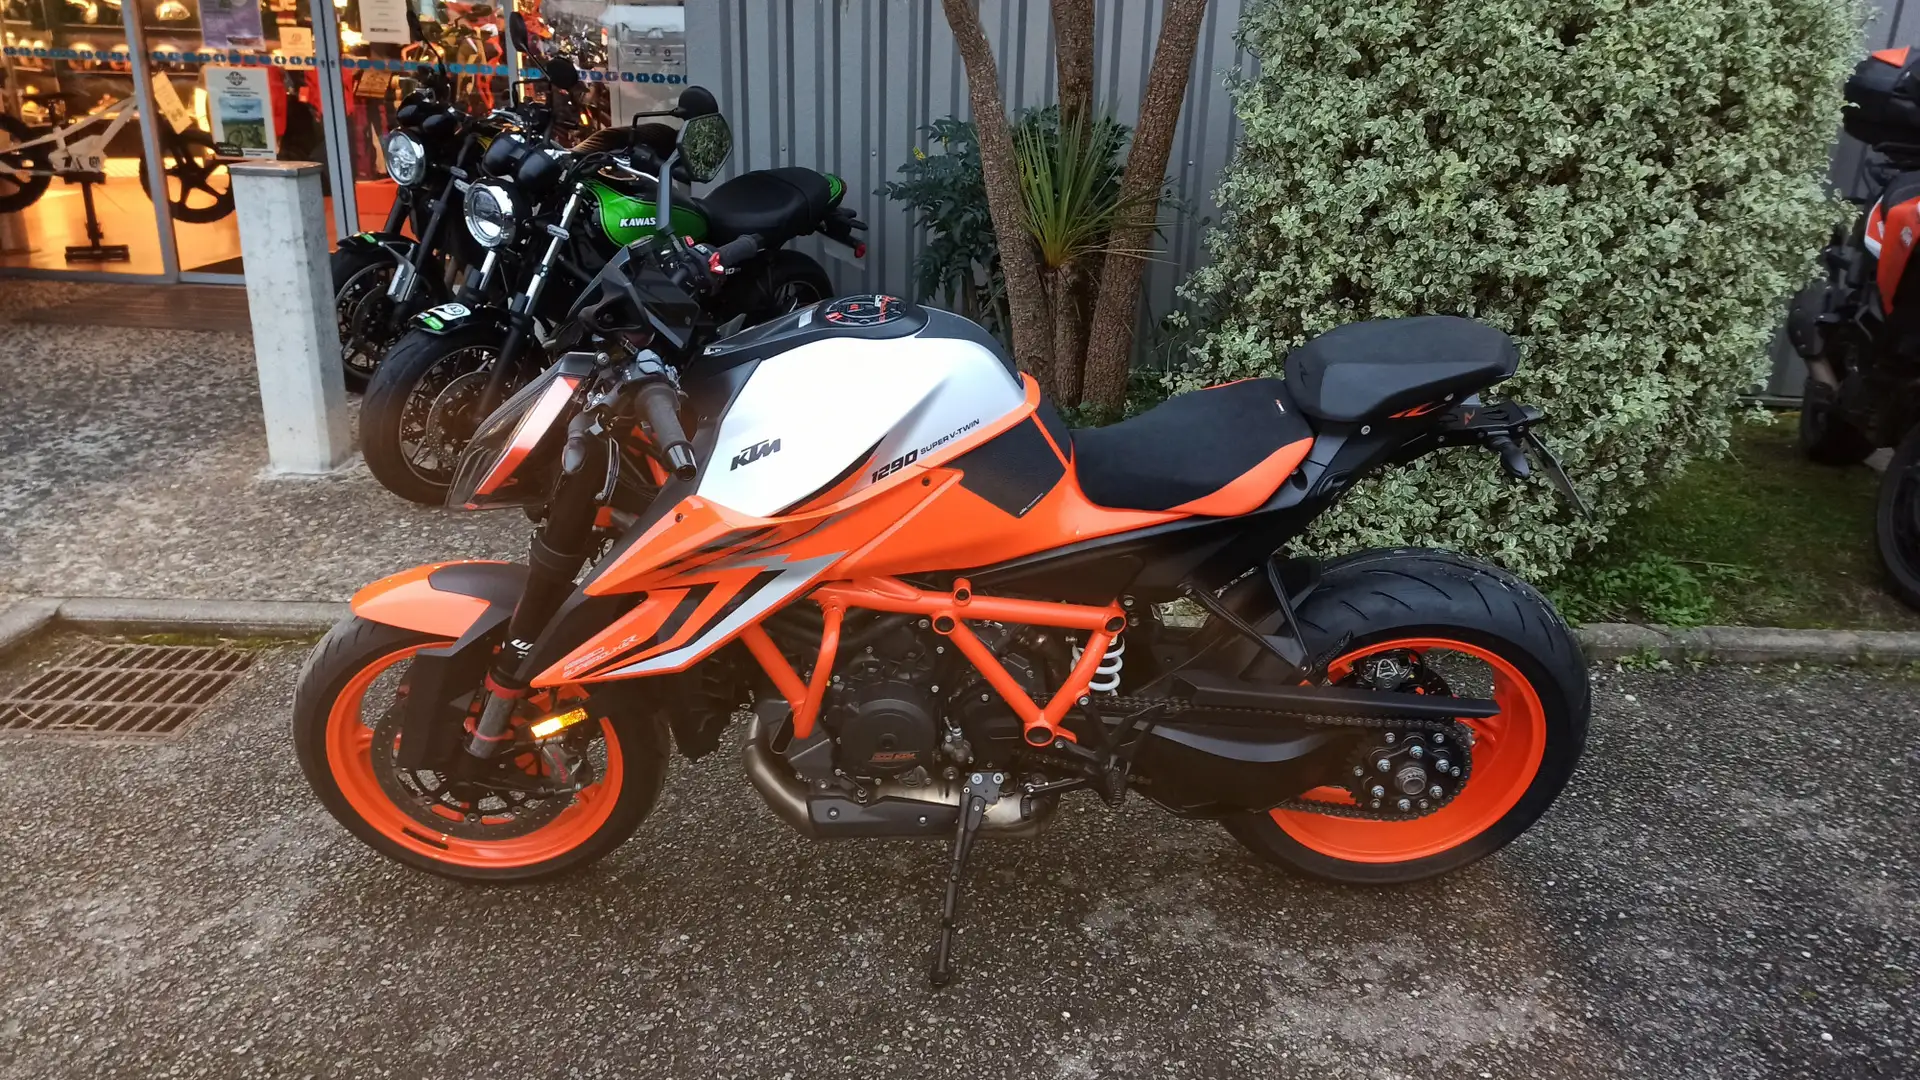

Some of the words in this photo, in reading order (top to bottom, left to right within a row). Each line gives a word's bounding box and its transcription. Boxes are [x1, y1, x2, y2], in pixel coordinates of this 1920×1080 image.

[620, 217, 656, 227] KAWAS
[730, 438, 781, 471] KTM
[871, 449, 918, 484] 1290
[920, 437, 949, 456] SUPER
[949, 418, 980, 440] V-TWIN
